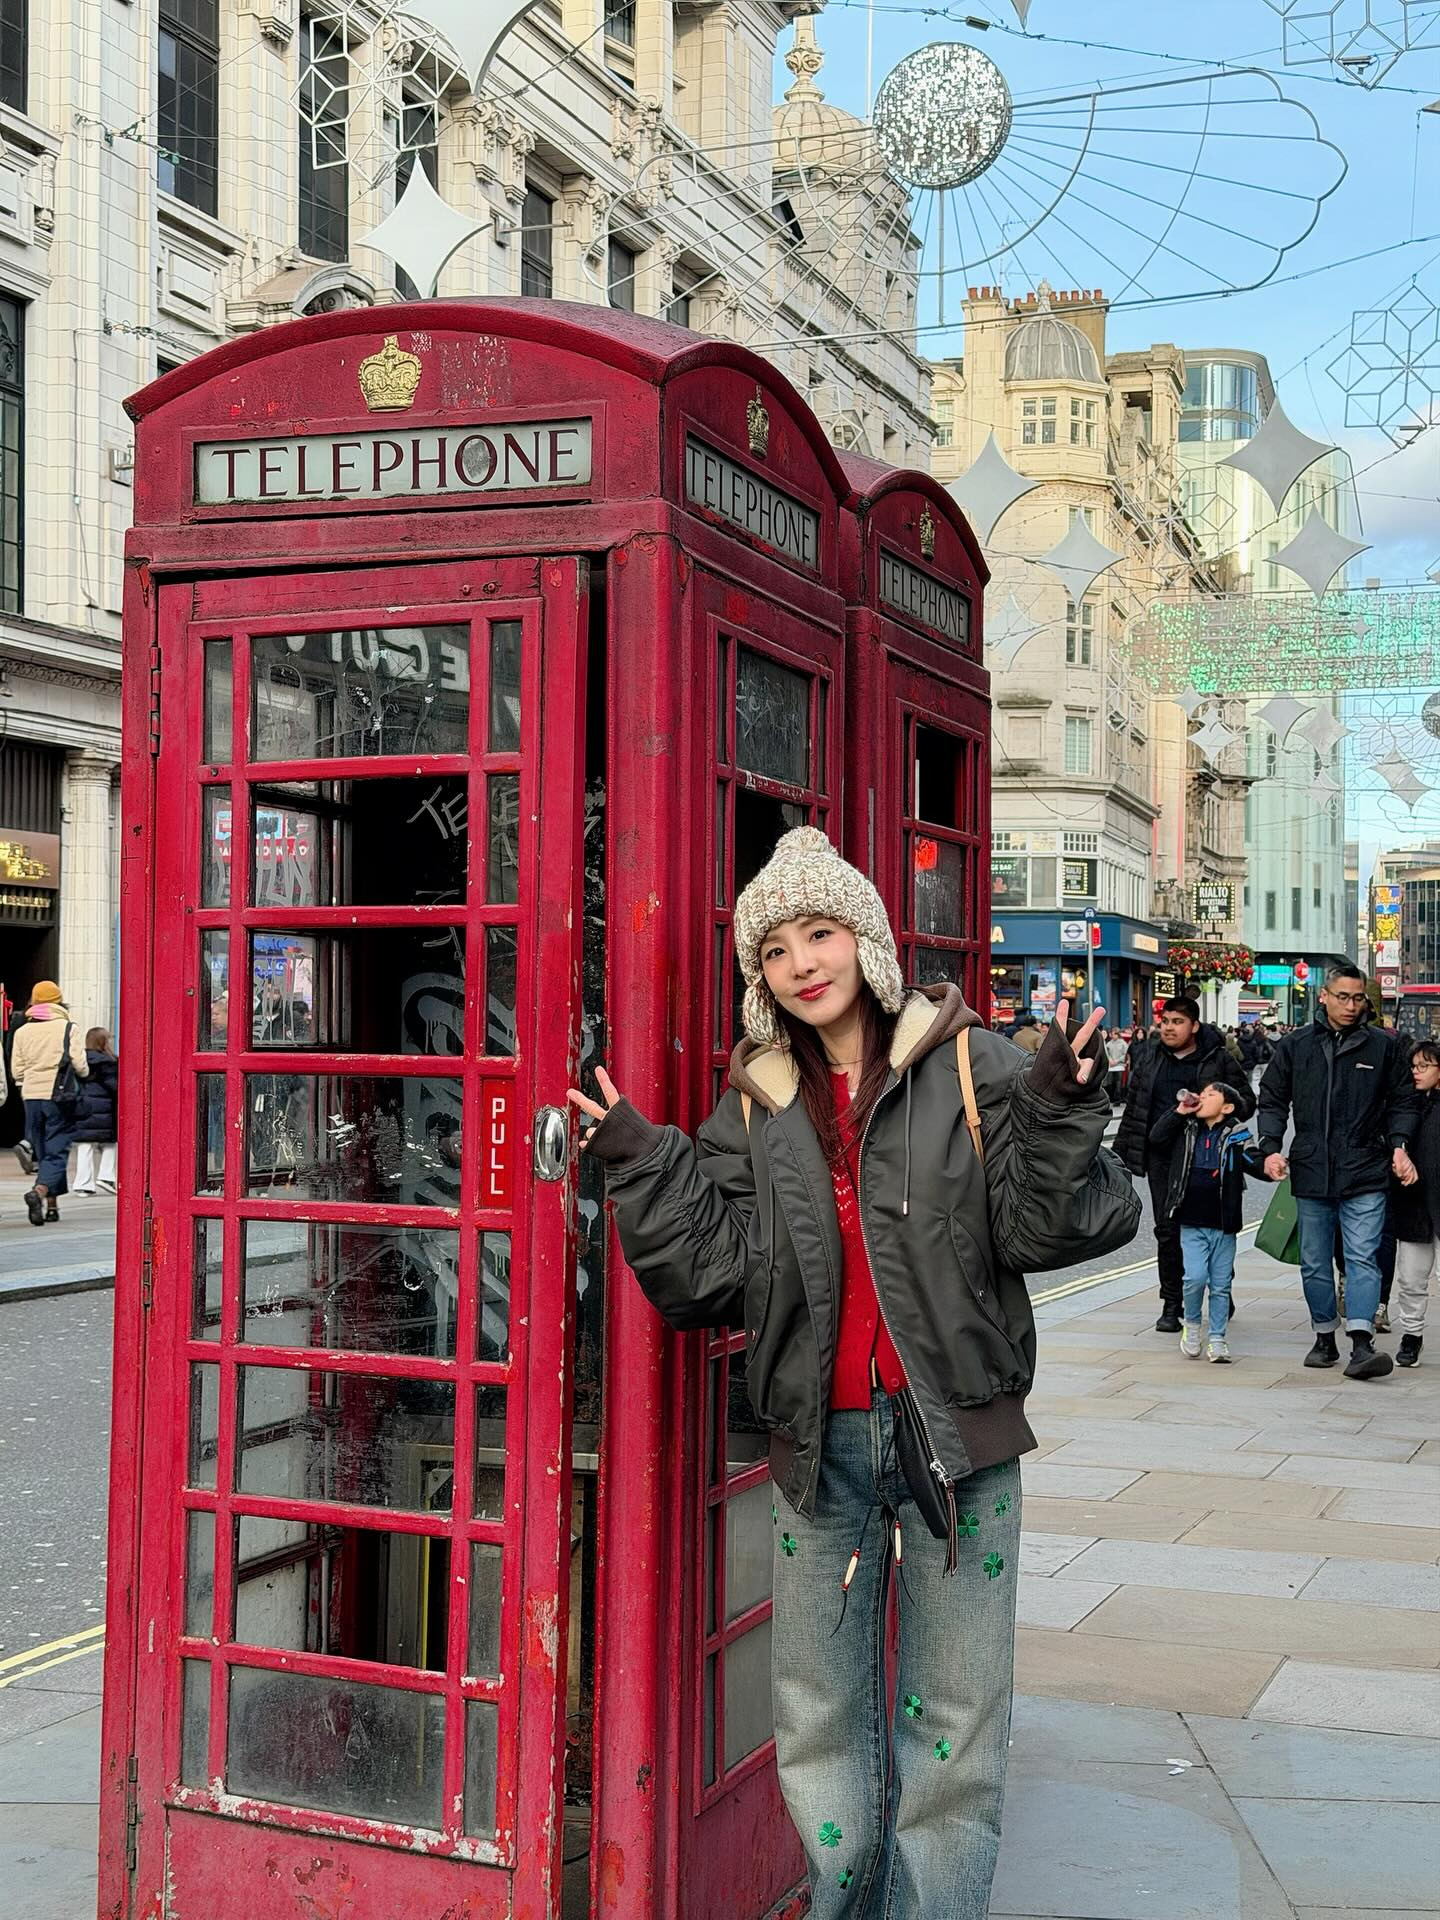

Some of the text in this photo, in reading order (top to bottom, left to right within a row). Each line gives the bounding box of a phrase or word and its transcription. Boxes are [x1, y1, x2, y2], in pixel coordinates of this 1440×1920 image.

[211, 428, 580, 499] TELEPHONE
[685, 446, 812, 563] TELEPHONE
[880, 556, 965, 641] TELEPHONE
[1199, 886, 1229, 898] RIALTO
[490, 1097, 506, 1195] PULL
